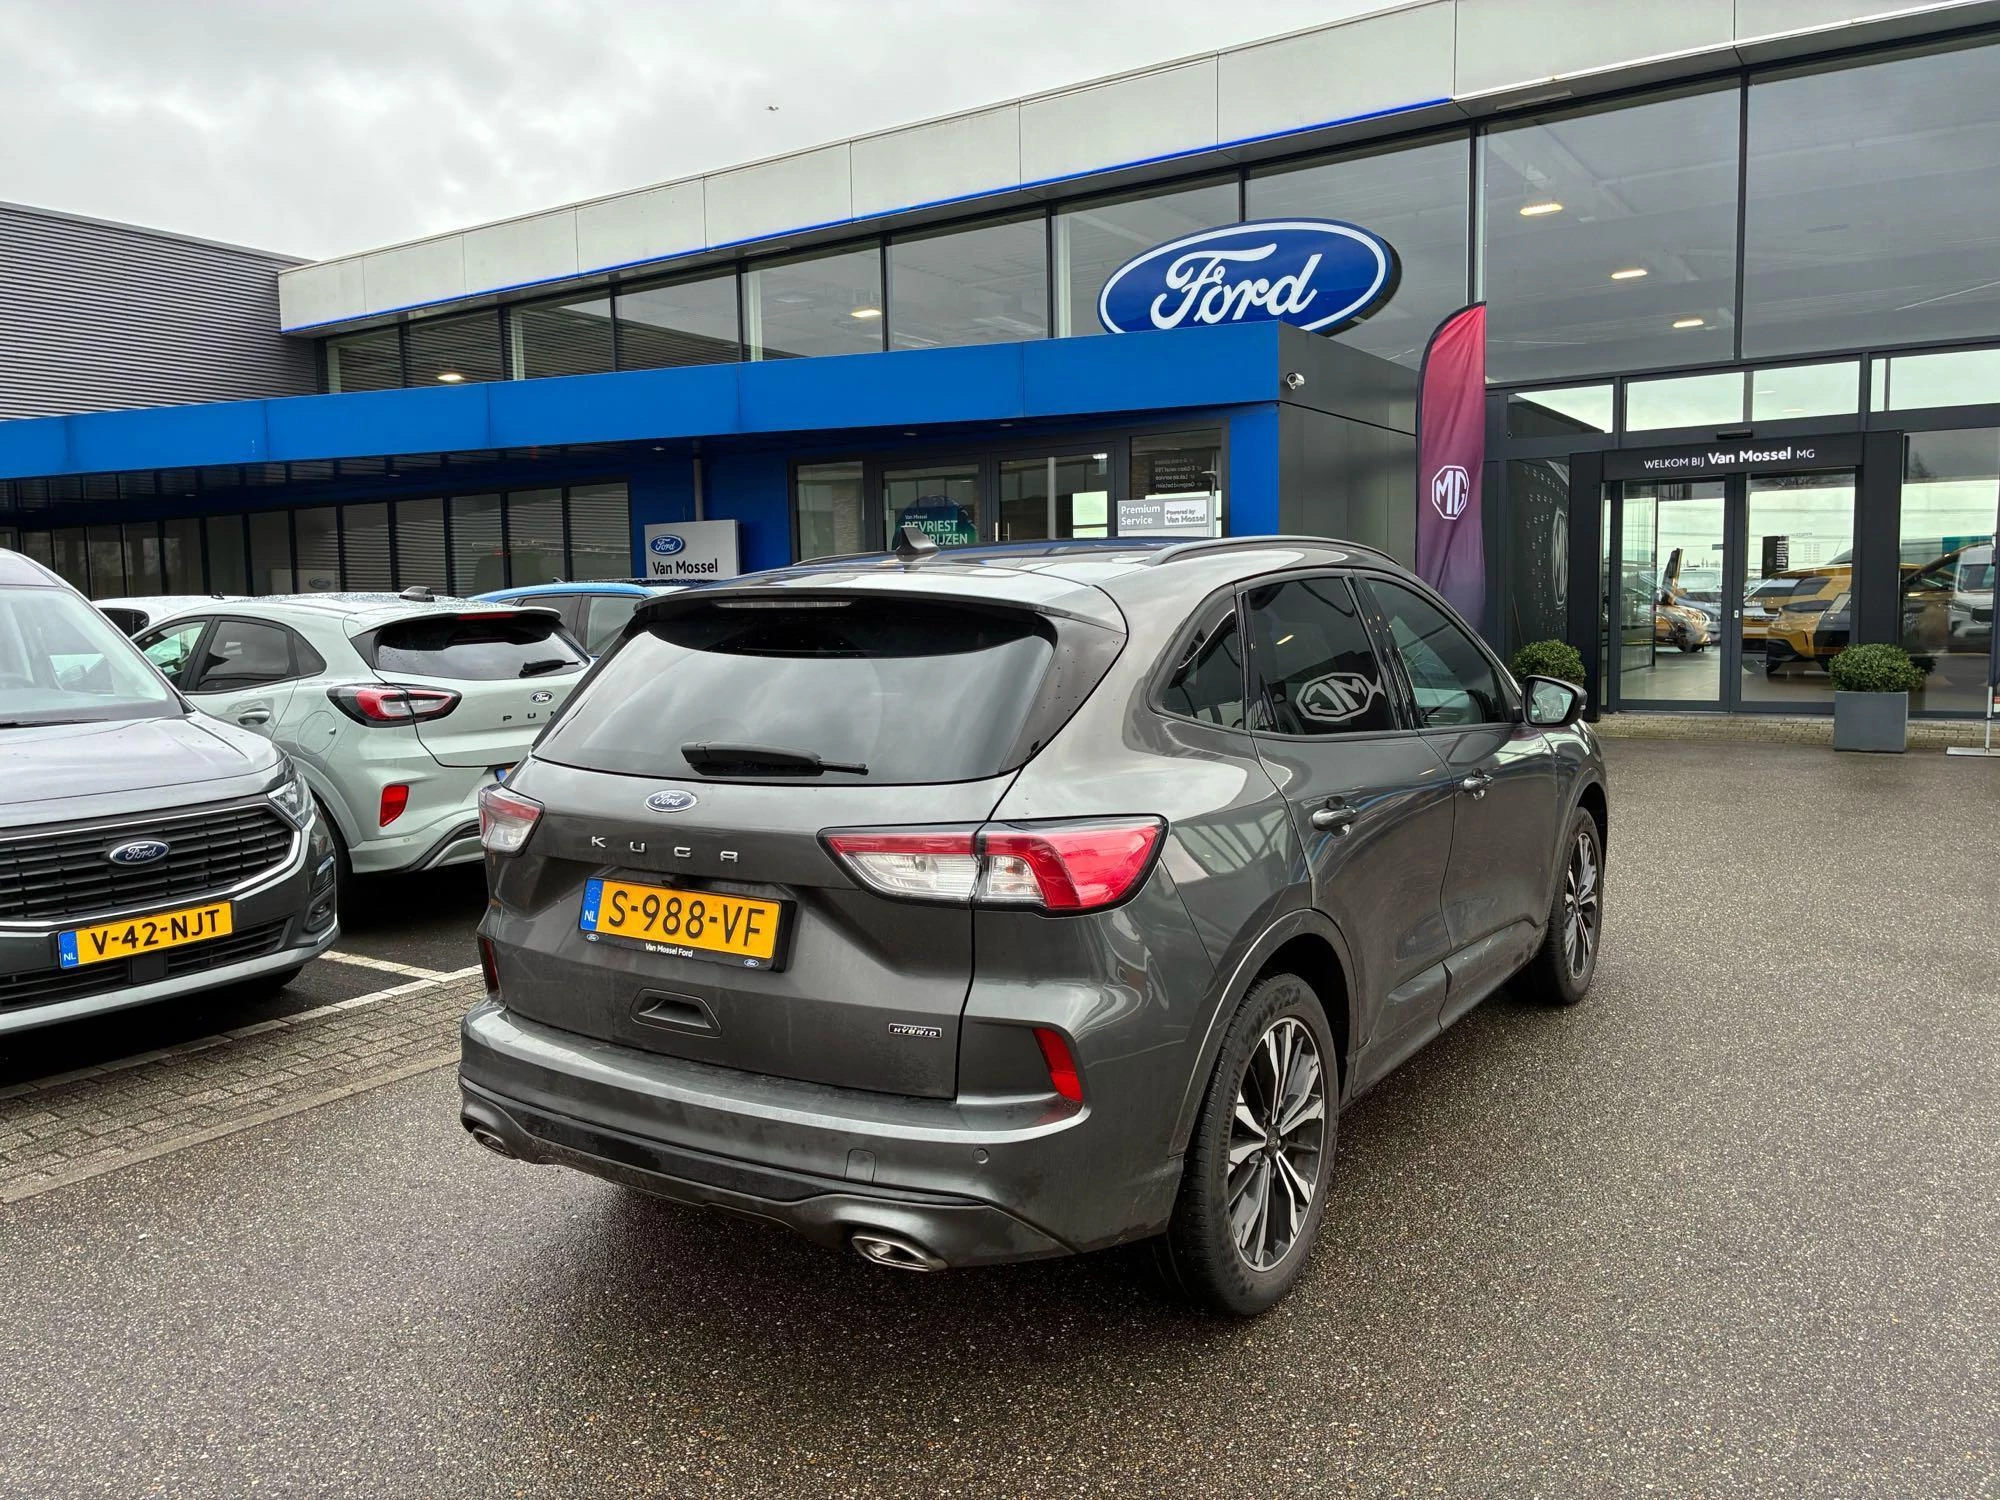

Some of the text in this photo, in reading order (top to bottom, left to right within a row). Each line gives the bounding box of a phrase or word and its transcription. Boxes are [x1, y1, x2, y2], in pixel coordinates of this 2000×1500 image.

[1150, 243, 1322, 329] Ford
[1644, 447, 1815, 469] WELKOM BIJ Van Mossel MG
[1435, 470, 1468, 515] MG
[1121, 505, 1160, 514] Premium
[1121, 516, 1153, 525] Service
[1181, 514, 1205, 523] Mossel
[655, 538, 676, 550] Ford
[652, 558, 718, 575] Van Mossel
[655, 793, 685, 806] Ford
[125, 845, 157, 860] Ford
[591, 836, 739, 863] KUGA
[583, 910, 597, 923] NL
[608, 889, 766, 947] S-988-VF
[90, 909, 220, 955] V-42-NJT
[63, 952, 77, 961] NL
[645, 943, 693, 957] Van Mossel Ford
[893, 1026, 937, 1036] HYBRID
